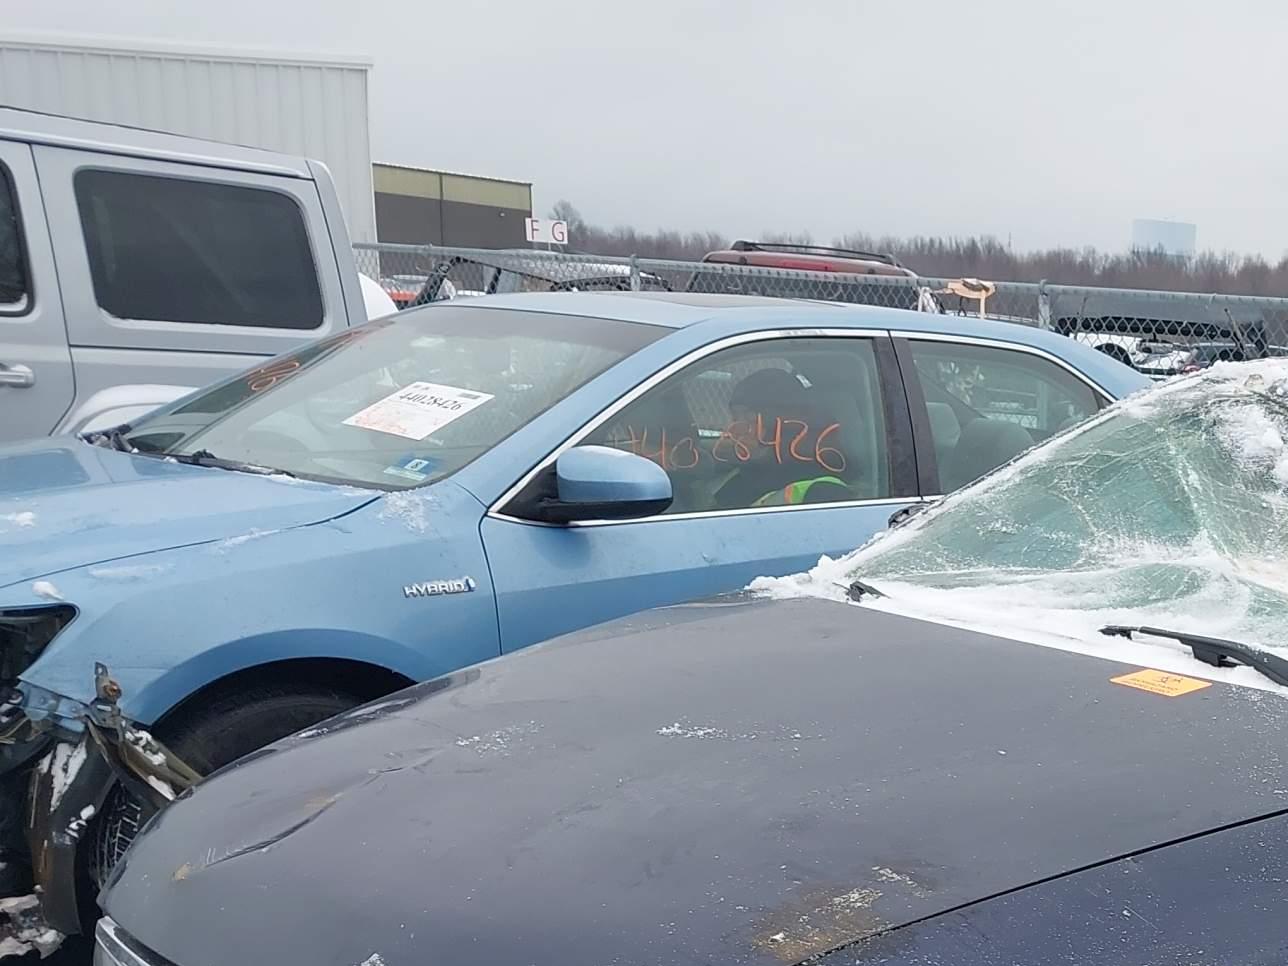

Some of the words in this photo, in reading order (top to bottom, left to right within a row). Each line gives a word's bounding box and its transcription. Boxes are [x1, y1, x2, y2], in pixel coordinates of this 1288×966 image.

[531, 220, 540, 241] F
[551, 221, 565, 242] G
[403, 582, 466, 598] HYBRID
